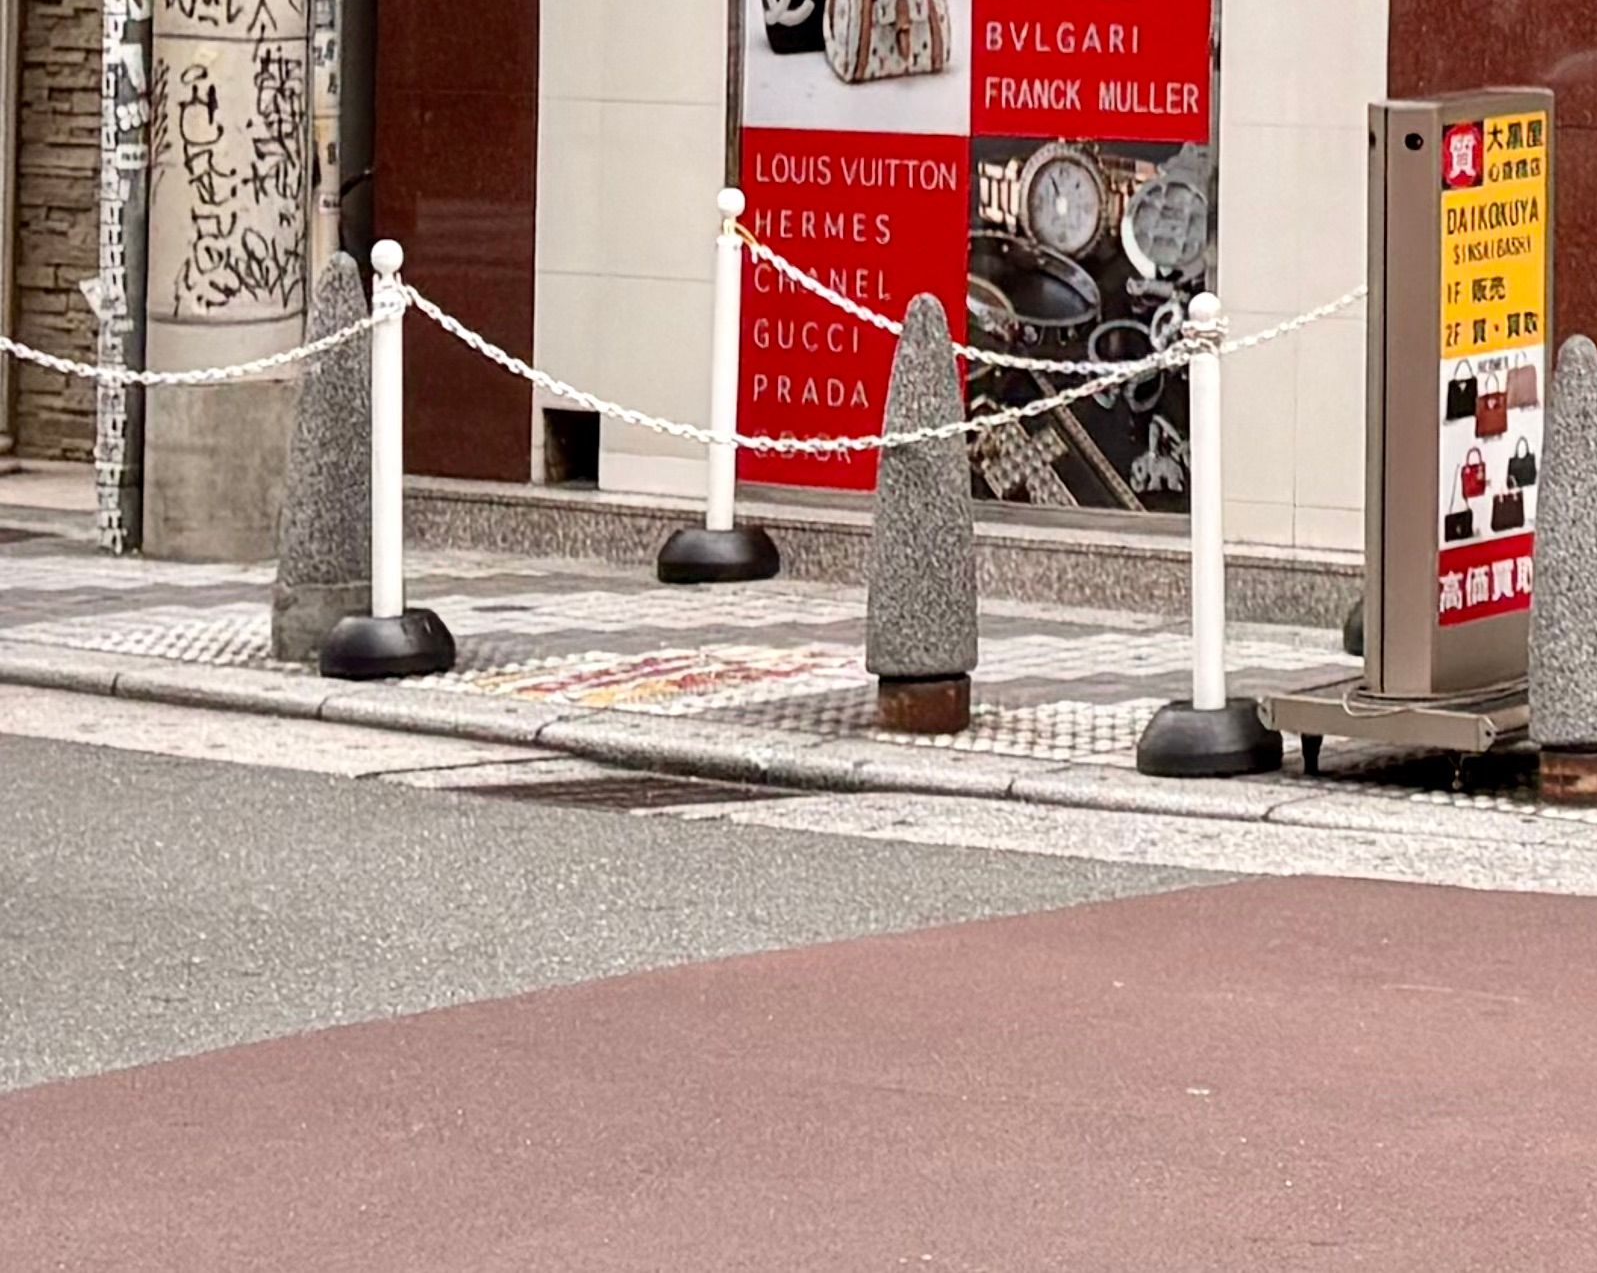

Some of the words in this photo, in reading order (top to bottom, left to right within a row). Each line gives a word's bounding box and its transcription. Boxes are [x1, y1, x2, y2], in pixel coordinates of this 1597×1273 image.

[986, 21, 1139, 54] BVLGARI
[985, 77, 1081, 111] FRANCK
[1099, 81, 1199, 114] MULLER
[1486, 119, 1544, 152] 大黒屋
[756, 153, 832, 185] LOUIS
[841, 156, 957, 191] VUITTON
[754, 208, 891, 244] HERMES
[1447, 196, 1539, 236] DAIKOKUYA
[1447, 281, 1461, 304] 1F
[1471, 276, 1506, 303] 販売
[753, 318, 859, 353] GUCCI
[1445, 322, 1461, 347] 2F
[753, 374, 869, 409] PRADA
[1440, 555, 1533, 613] 高価買取
